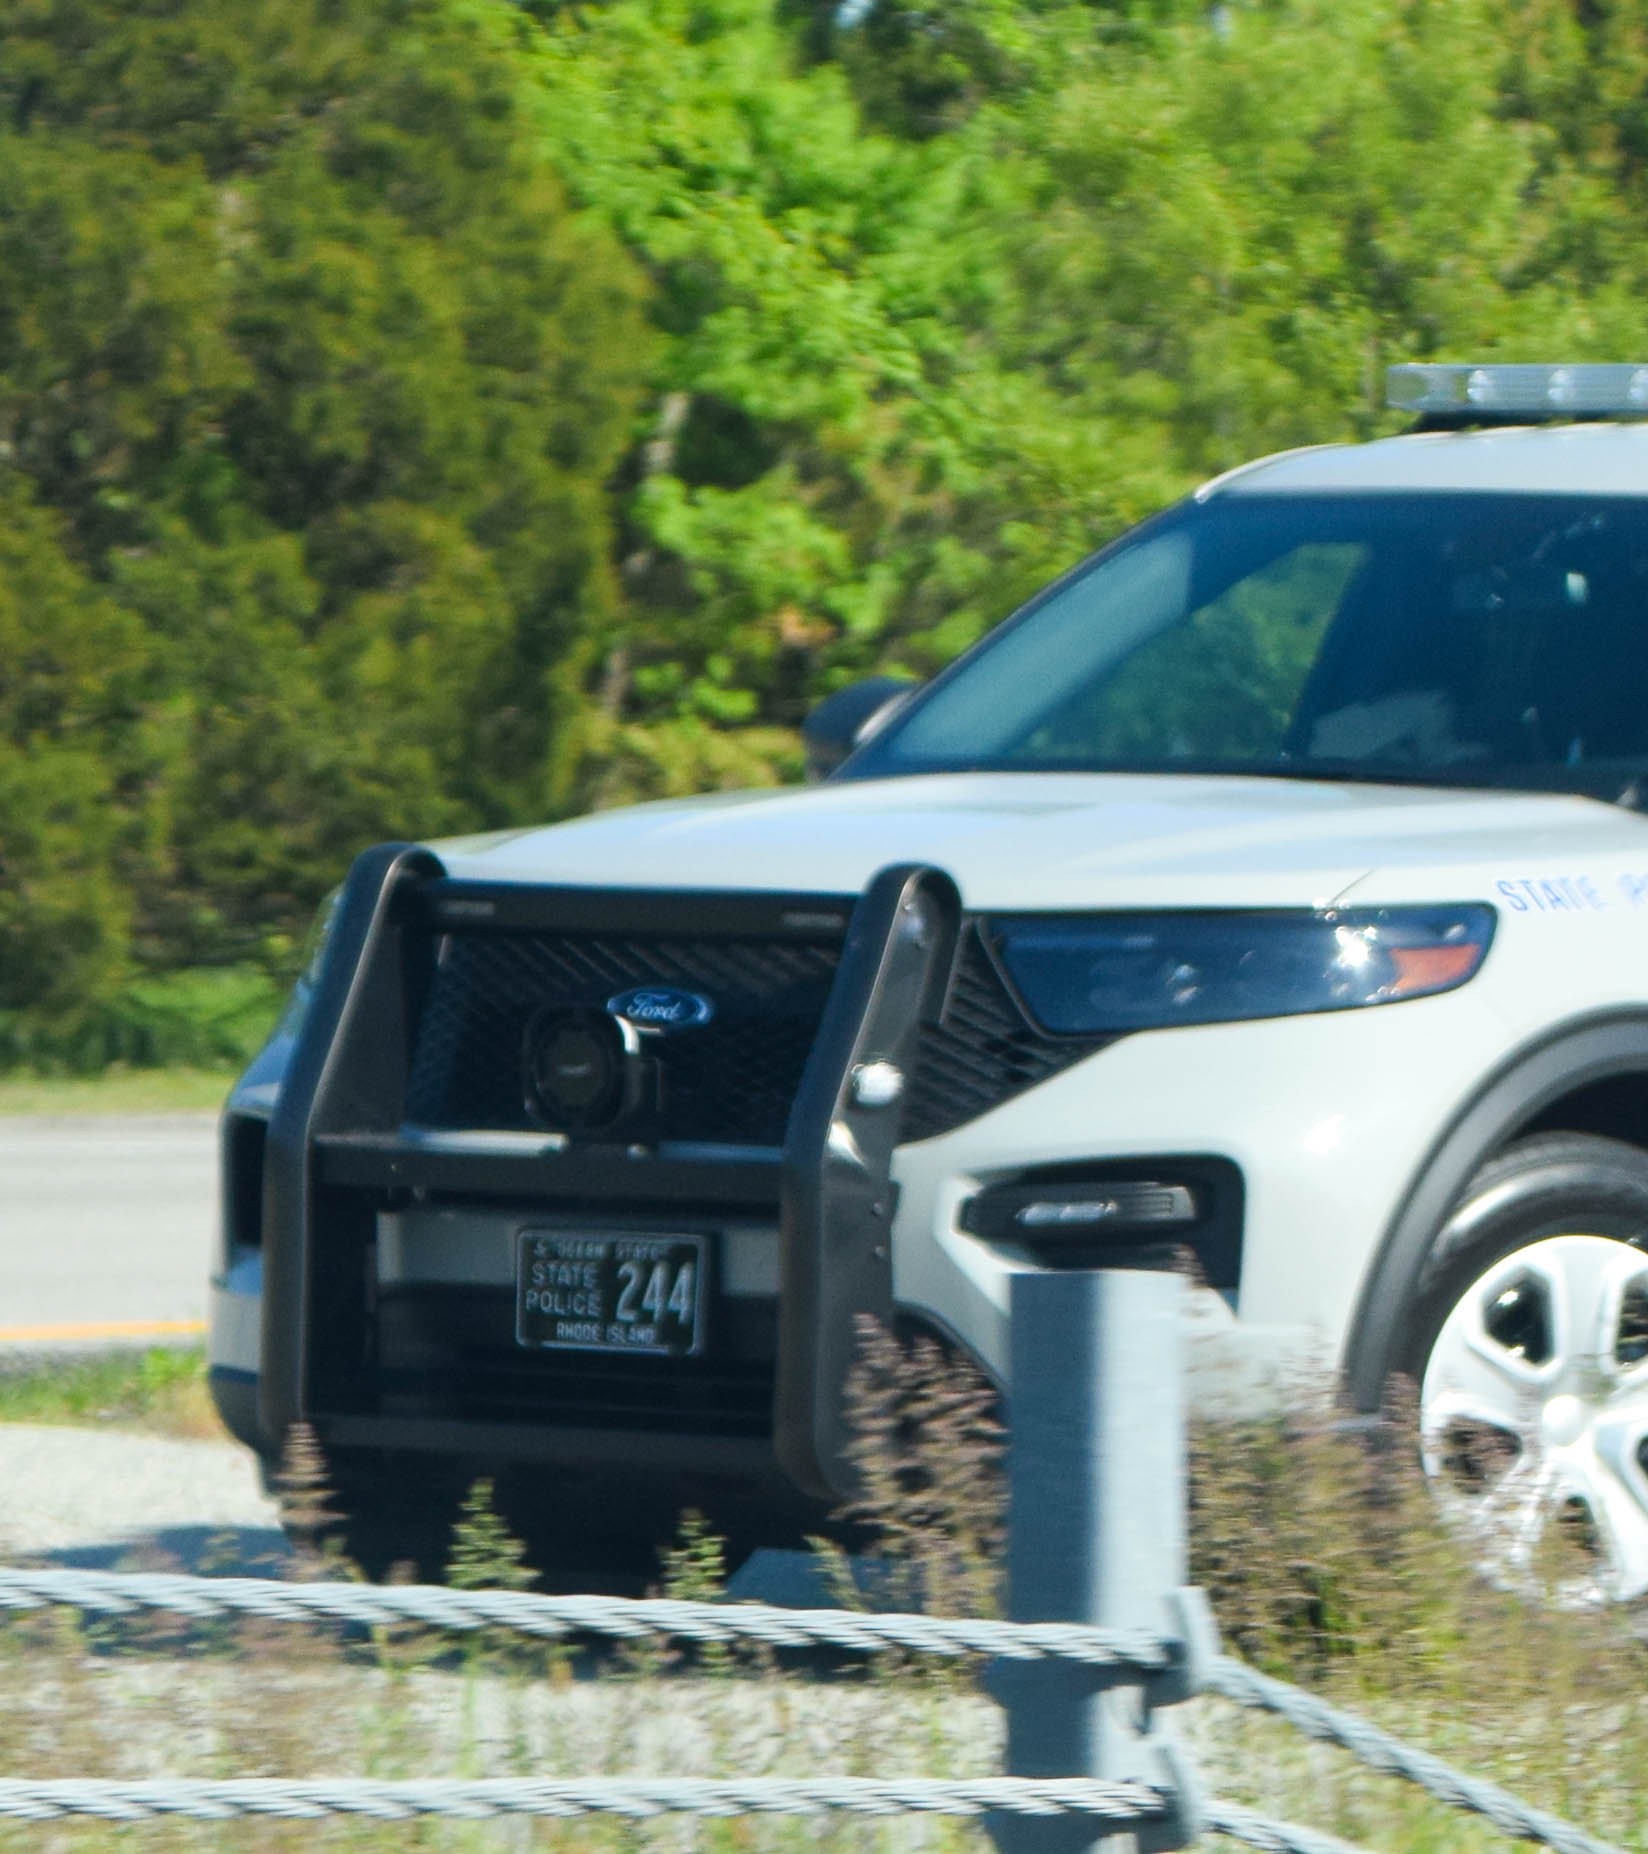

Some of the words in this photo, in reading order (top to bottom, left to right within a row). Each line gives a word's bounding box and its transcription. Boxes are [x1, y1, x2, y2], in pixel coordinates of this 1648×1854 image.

[1495, 874, 1606, 912] STATE
[626, 992, 682, 1019] Ford
[531, 1261, 599, 1288] STATE
[525, 1289, 602, 1317] POLICE
[616, 1260, 695, 1325] 244
[556, 1322, 601, 1342] RHODE
[605, 1324, 658, 1345] ISLAND
